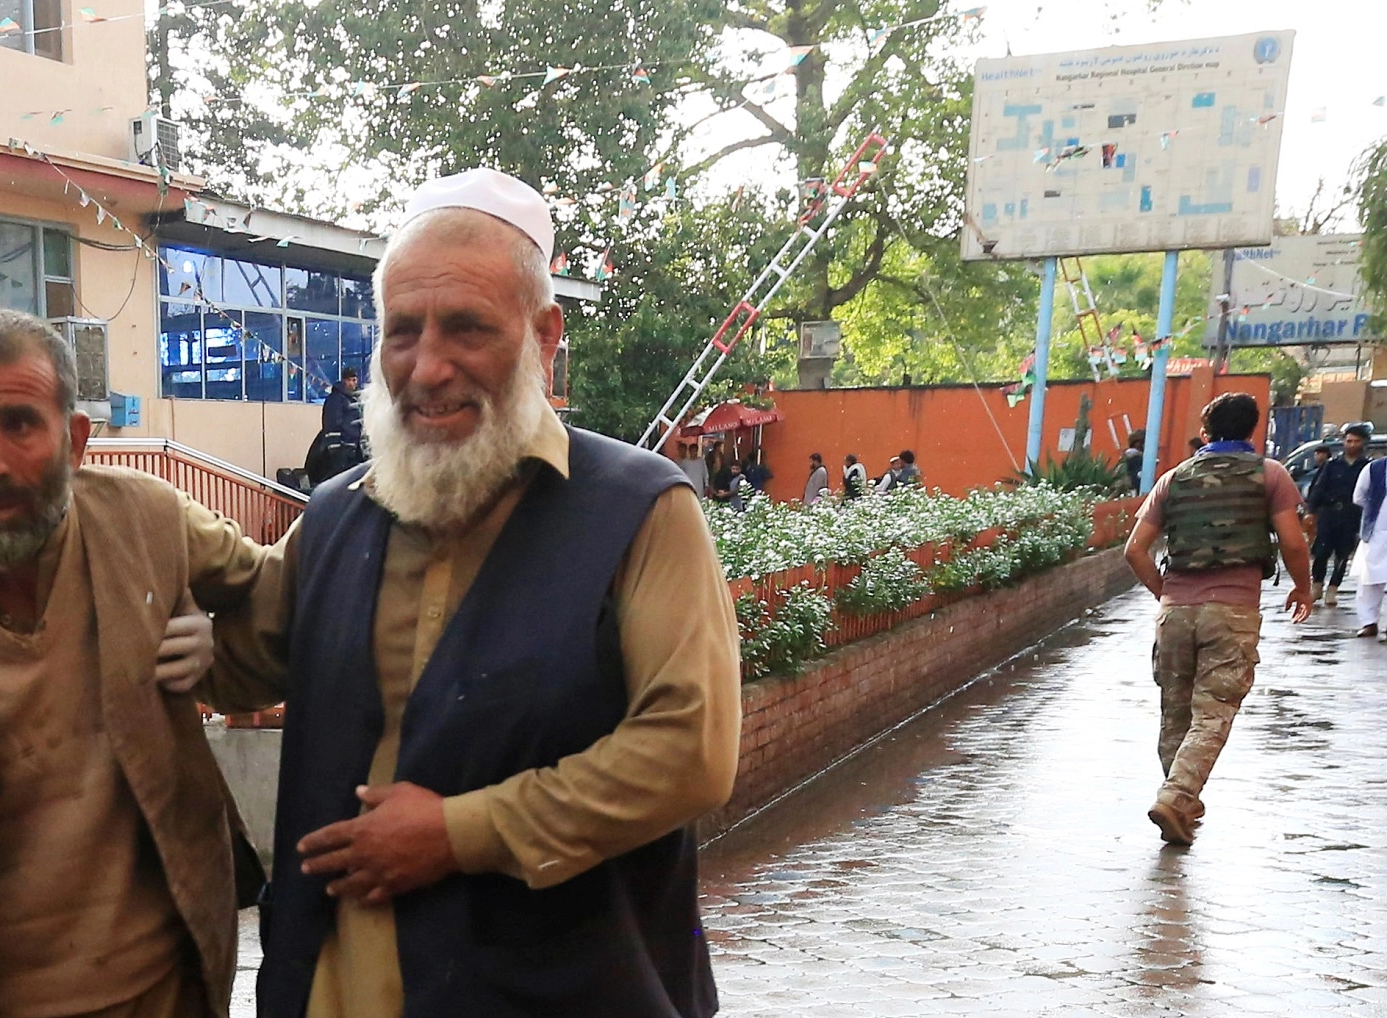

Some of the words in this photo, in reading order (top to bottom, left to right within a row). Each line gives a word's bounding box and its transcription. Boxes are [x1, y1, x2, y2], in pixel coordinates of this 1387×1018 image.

[1226, 316, 1347, 343] Nangarhar
[746, 415, 772, 424] MILANO
[708, 421, 738, 432] MILANO
